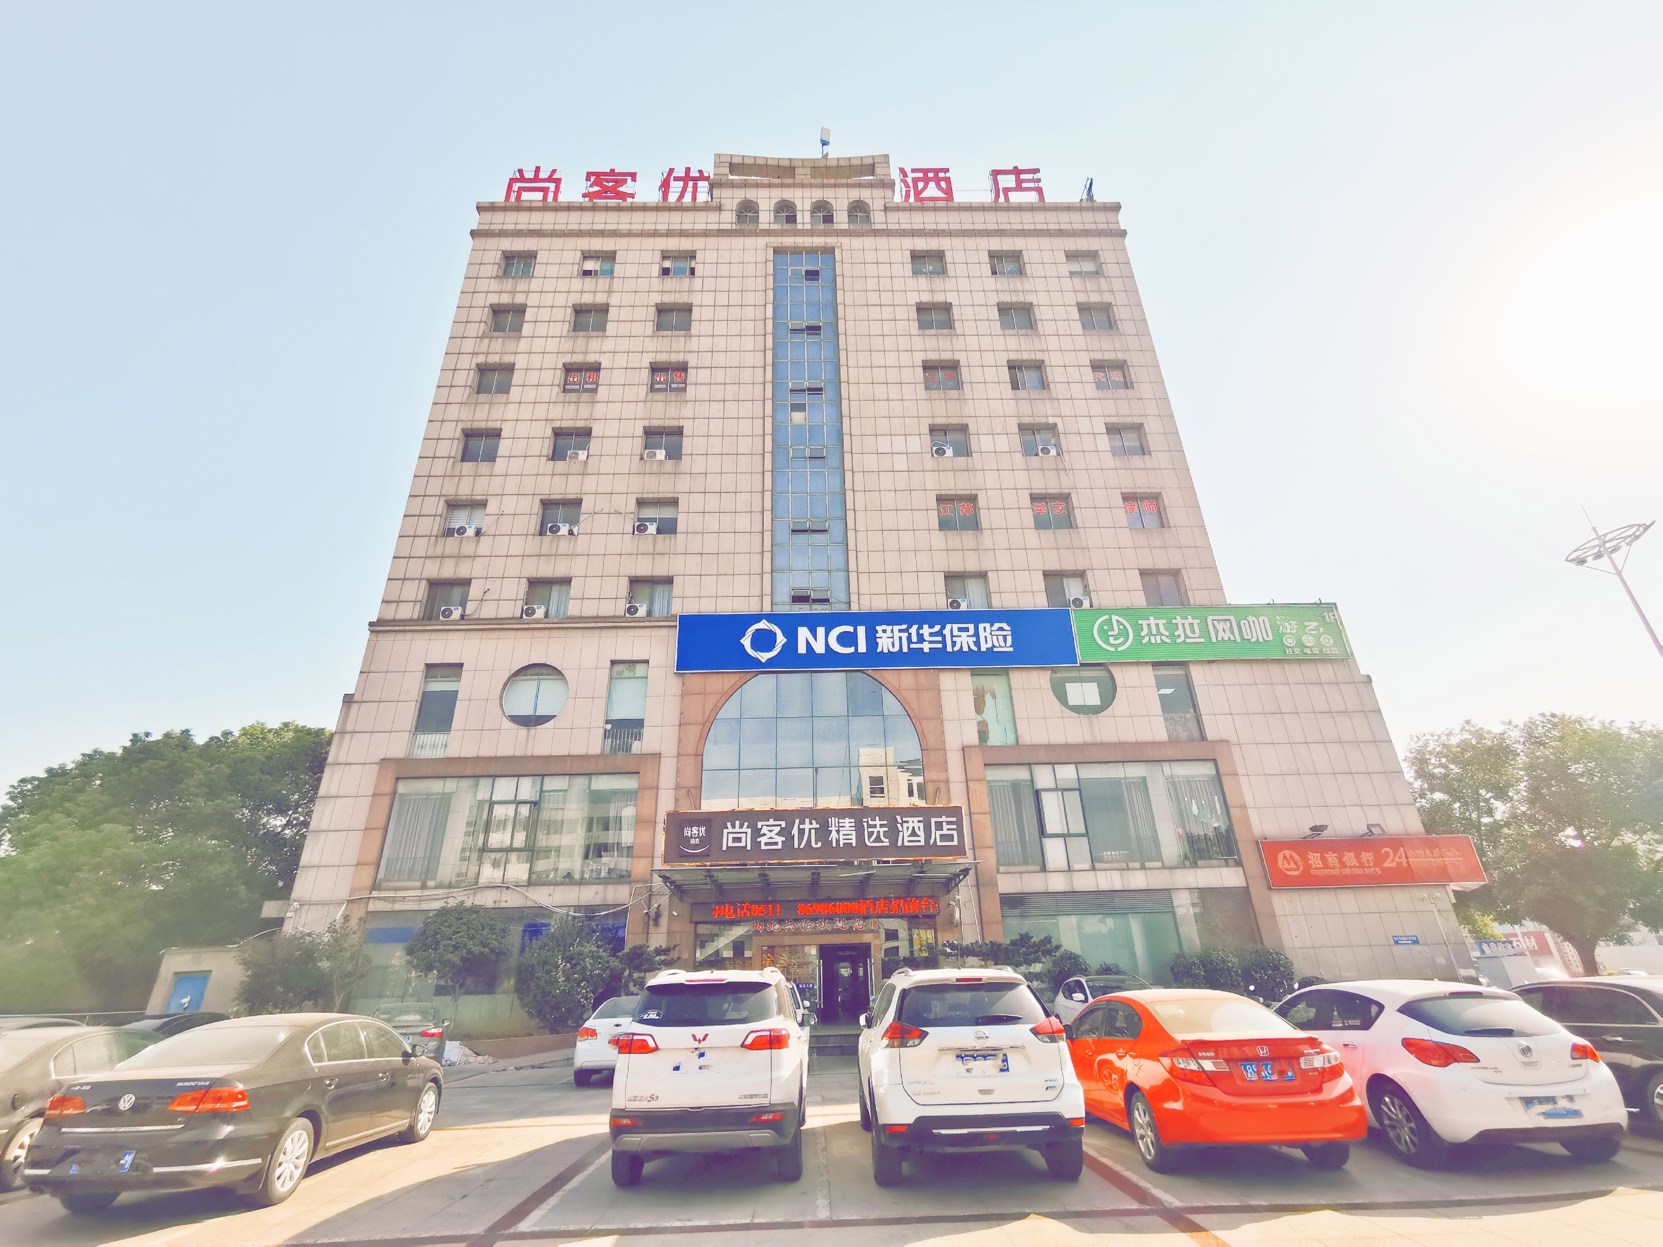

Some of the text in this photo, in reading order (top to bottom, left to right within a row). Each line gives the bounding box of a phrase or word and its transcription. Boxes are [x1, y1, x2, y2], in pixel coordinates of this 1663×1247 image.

[504, 166, 1046, 203] 尚客优 酒店
[567, 371, 599, 383] 出租
[938, 502, 975, 516] 江苏
[1123, 500, 1159, 514] 律师
[1137, 614, 1274, 643] 杰拉网咖
[796, 623, 1014, 656] NCI 新华保险
[683, 826, 707, 837] 尚客优
[721, 815, 959, 851] 尚客优精选酒店
[1306, 851, 1375, 868] 招商银行
[1381, 847, 1408, 868] 24
